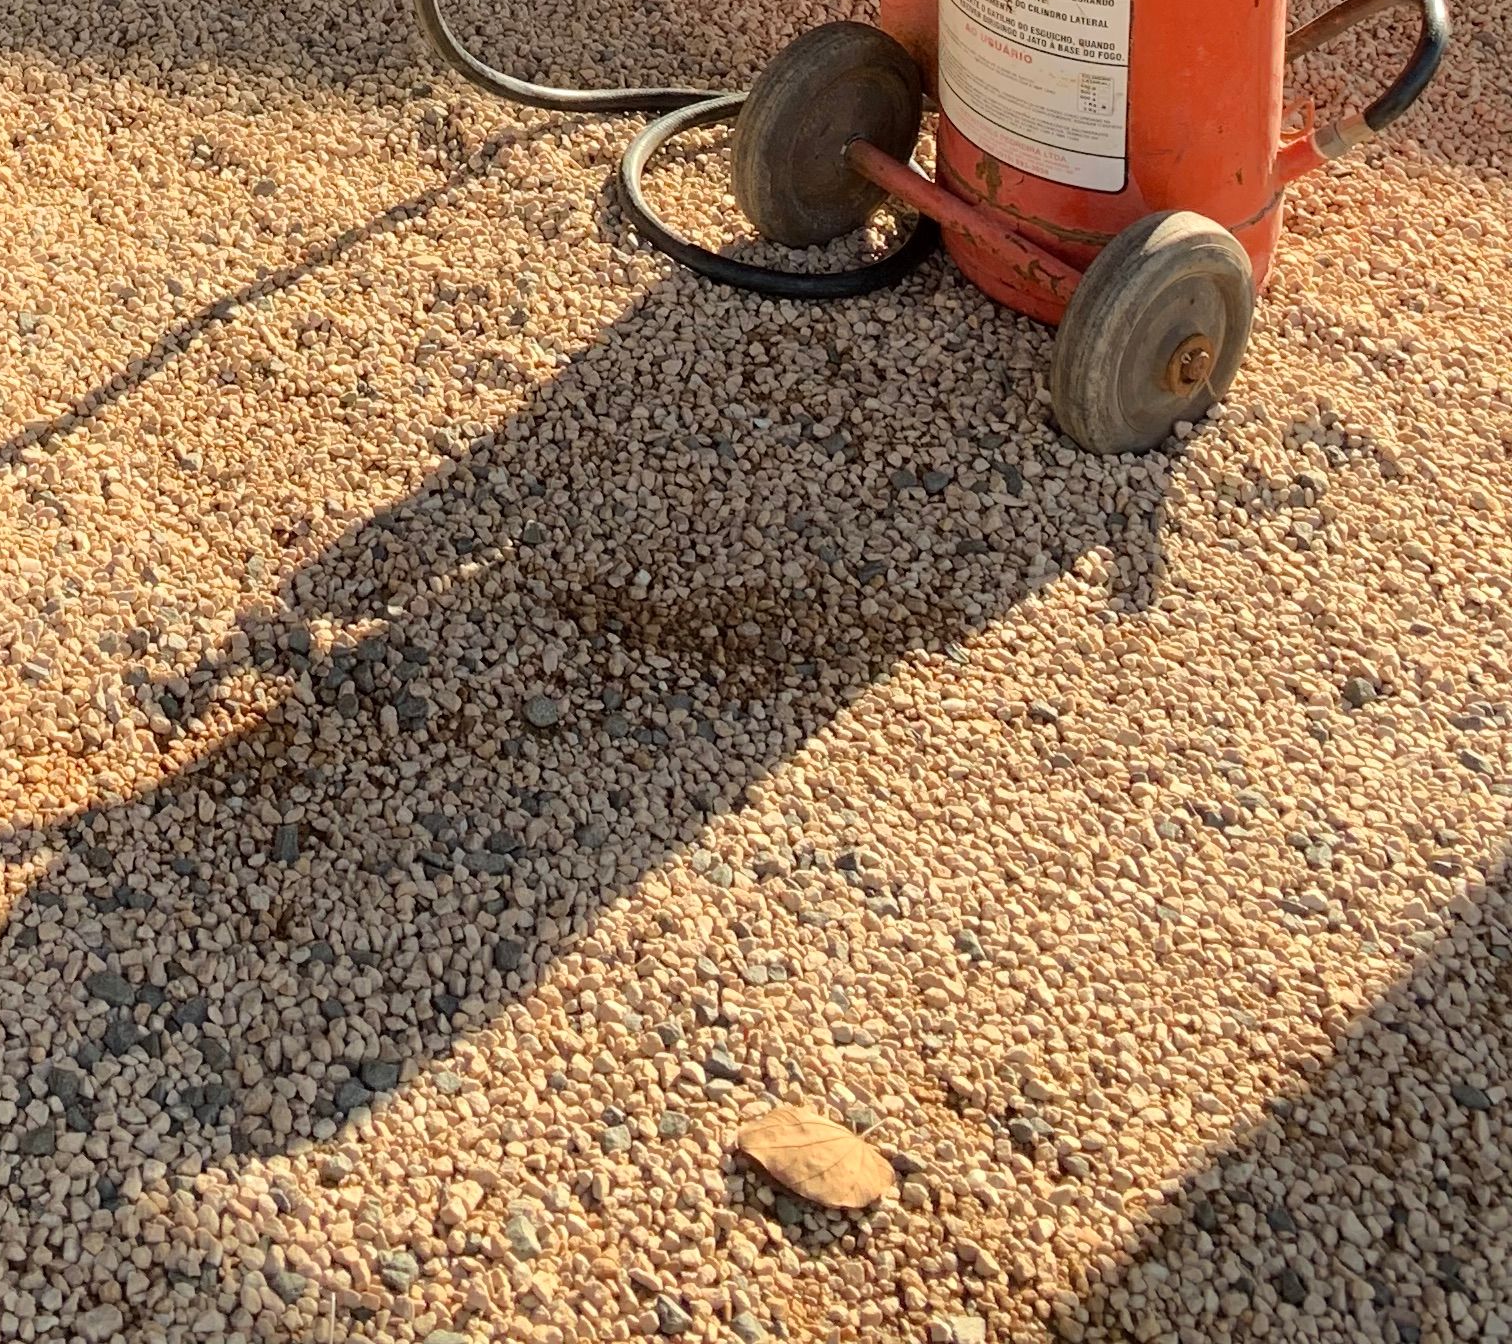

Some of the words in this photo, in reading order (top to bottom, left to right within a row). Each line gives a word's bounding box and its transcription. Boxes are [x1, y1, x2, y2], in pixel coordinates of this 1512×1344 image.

[1015, 0, 1026, 9] DO
[1028, 3, 1068, 22] CILINDRO
[1070, 15, 1109, 28] LATERAL
[980, 32, 1033, 64] USUÁRIO
[1018, 22, 1029, 32] DO
[1078, 38, 1115, 51] QUANDO
[1027, 35, 1047, 47] JATO
[1057, 43, 1080, 55] BASE
[1083, 49, 1095, 58] DO
